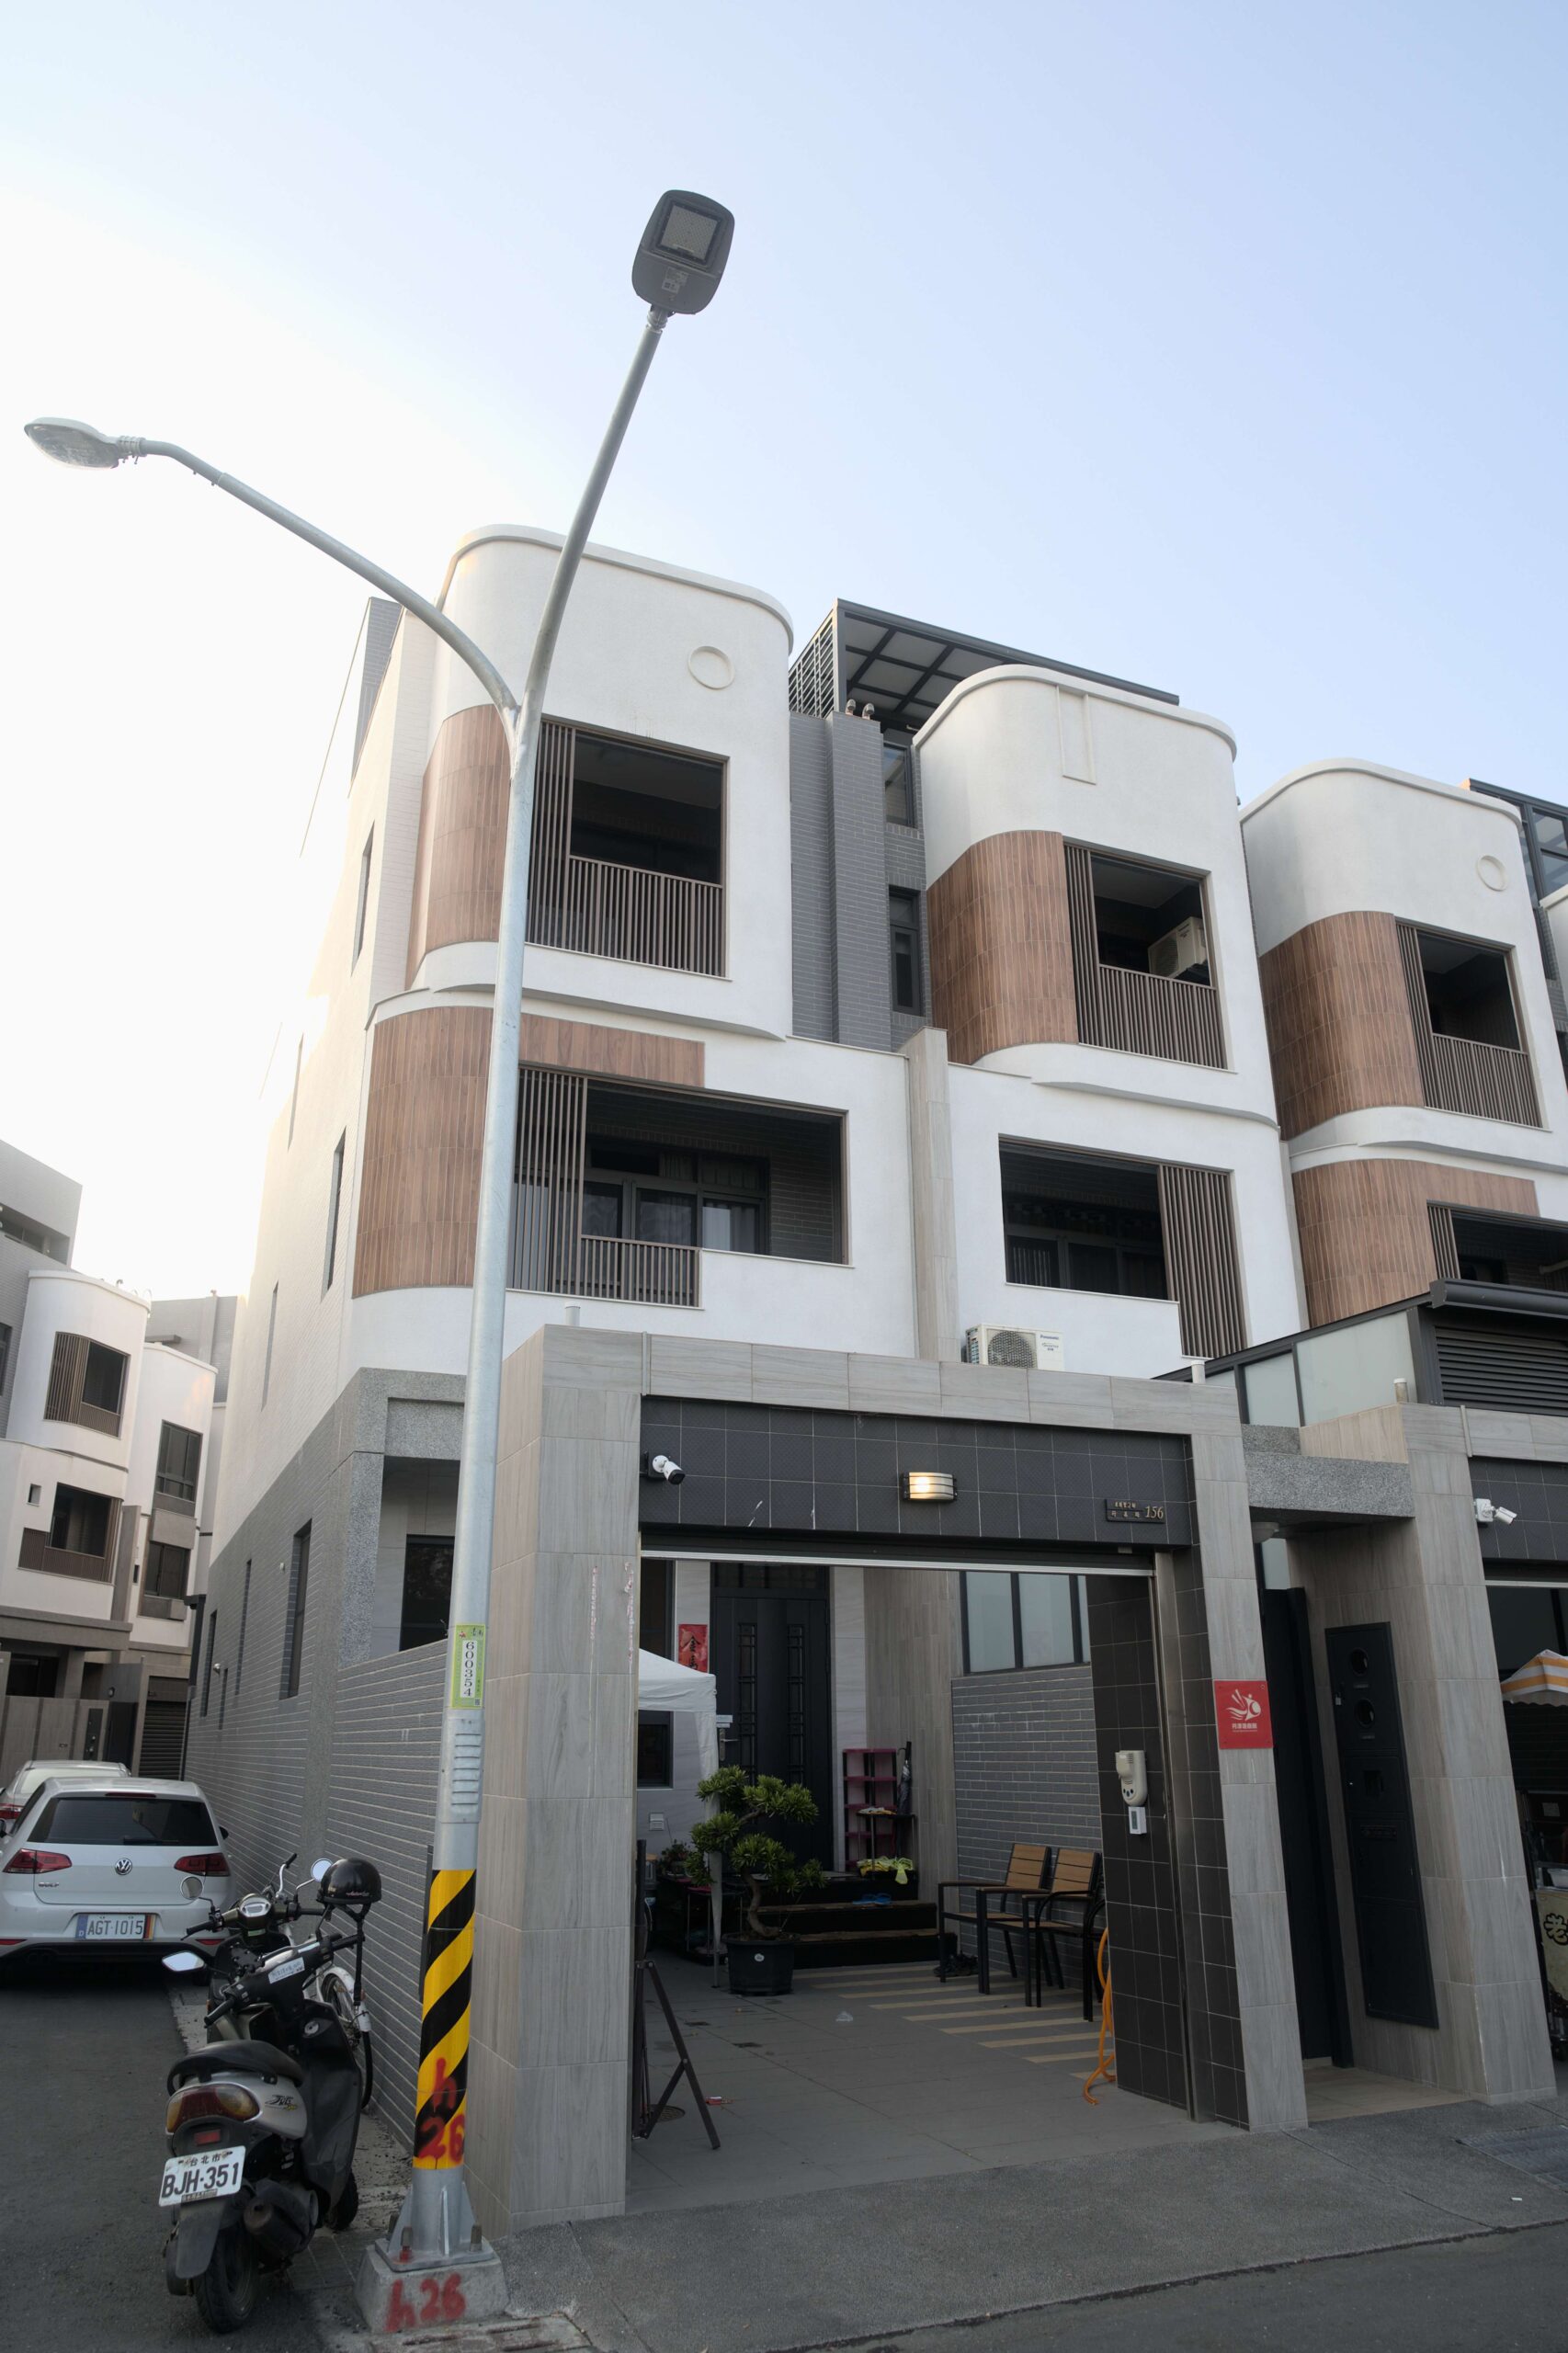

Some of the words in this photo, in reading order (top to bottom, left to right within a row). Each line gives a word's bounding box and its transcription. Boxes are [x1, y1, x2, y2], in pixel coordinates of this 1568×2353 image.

[1145, 1506, 1164, 1518] 156
[463, 1642, 475, 1697] 600354
[417, 2113, 466, 2165] 26
[190, 2153, 222, 2166] 台北市
